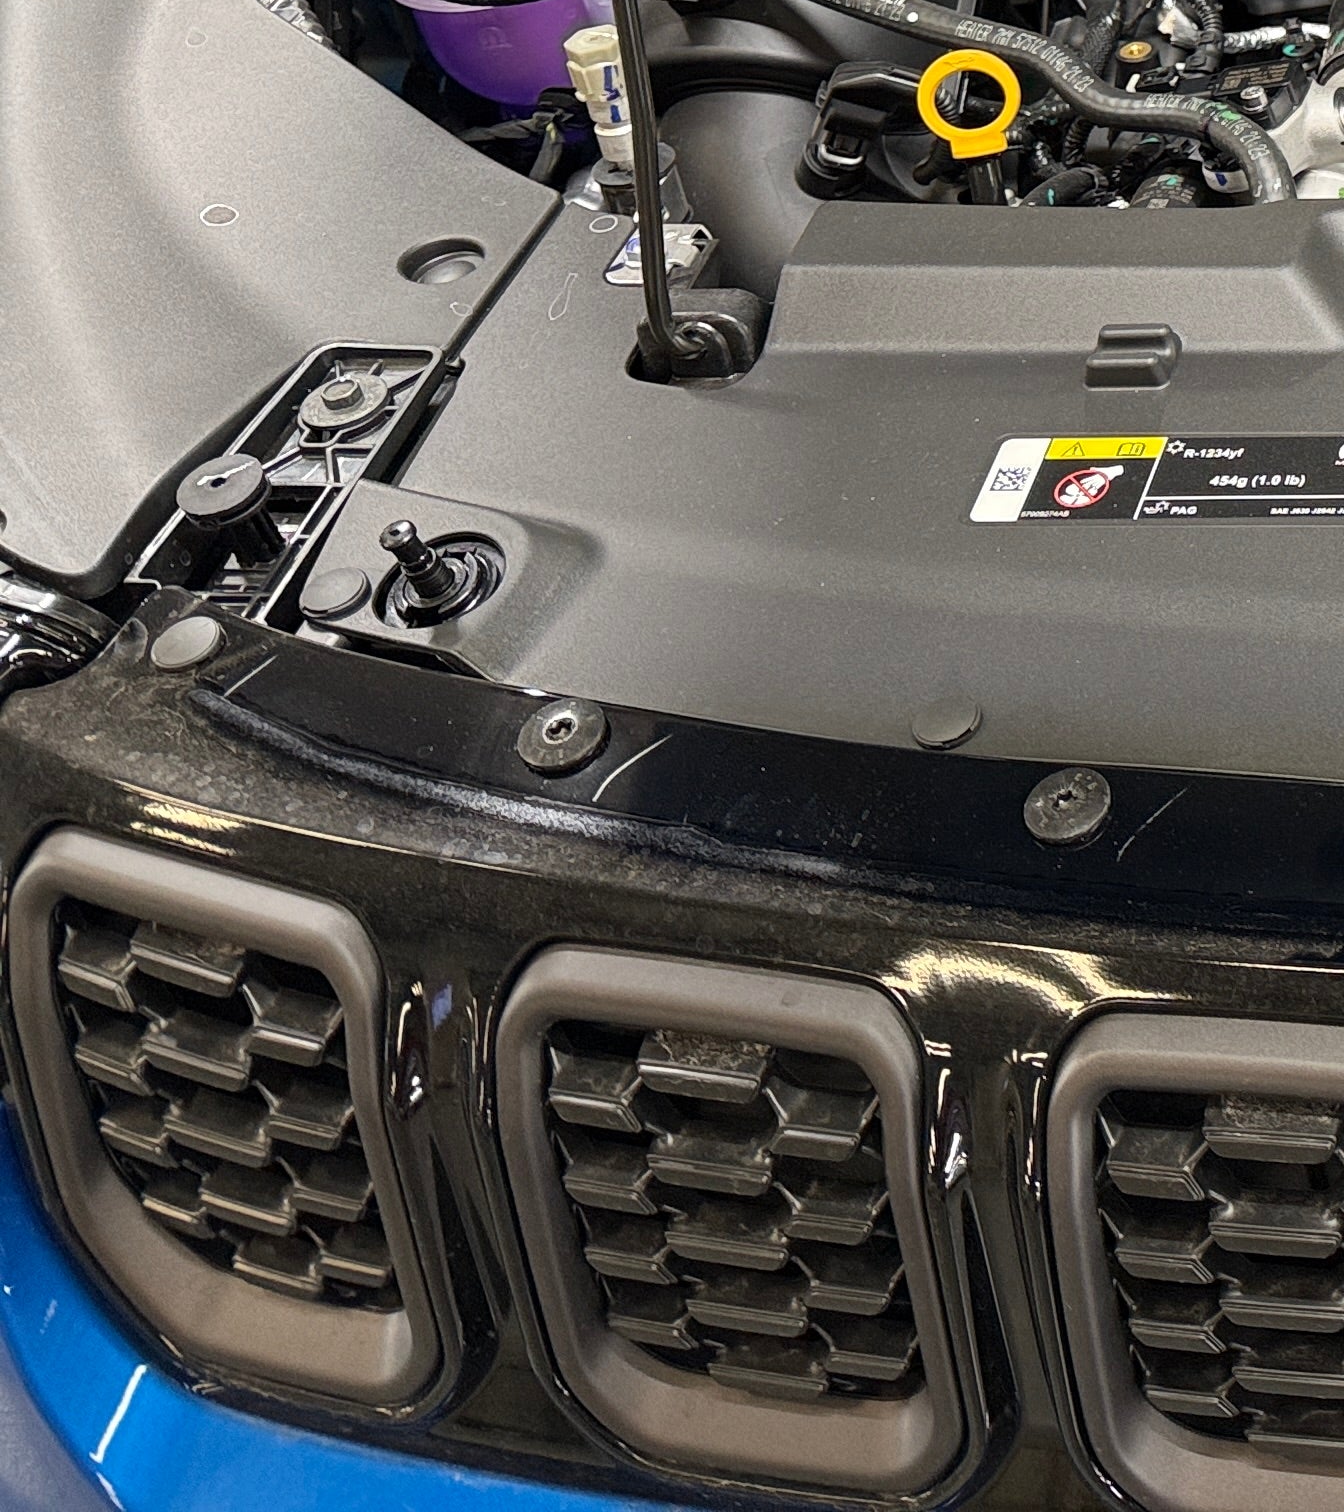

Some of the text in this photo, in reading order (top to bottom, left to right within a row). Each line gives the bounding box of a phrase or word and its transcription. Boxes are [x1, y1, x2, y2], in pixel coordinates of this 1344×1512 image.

[954, 19, 994, 42] HEATER
[1143, 93, 1185, 109] HEATER
[1183, 448, 1245, 460] R-1234yf
[1209, 474, 1306, 489] 454g (1.0 lb)
[1169, 506, 1198, 515] PAG
